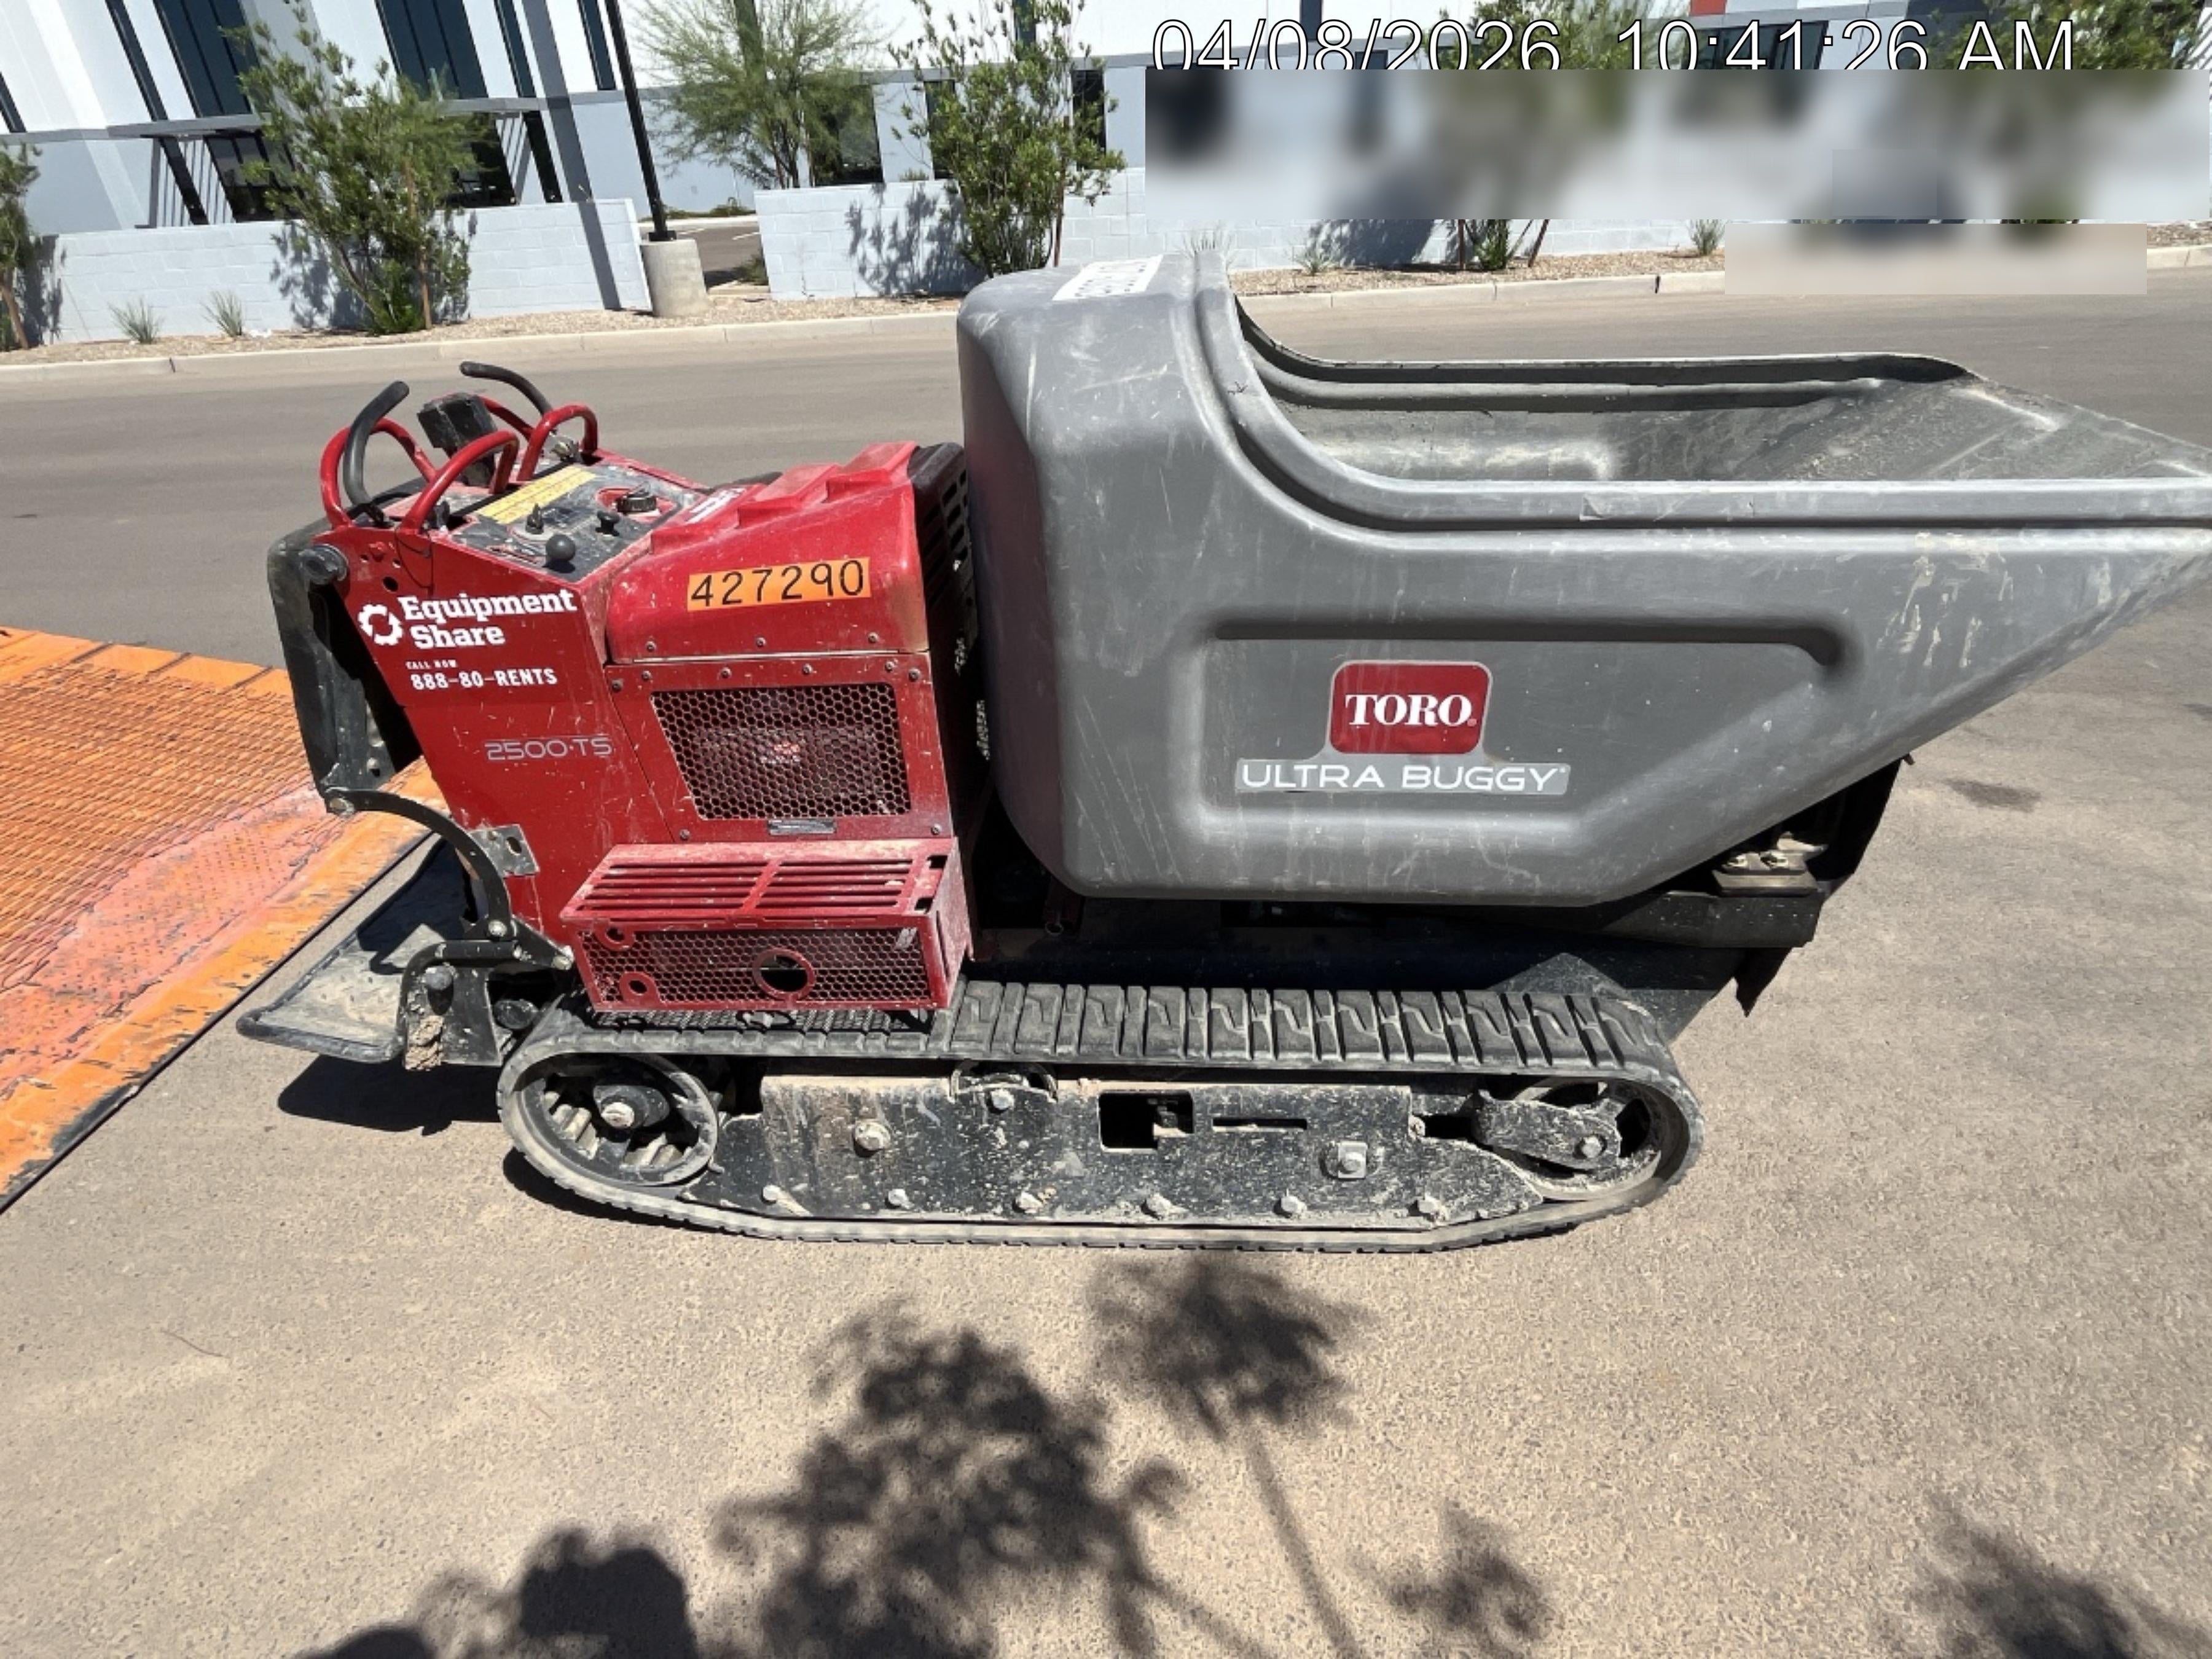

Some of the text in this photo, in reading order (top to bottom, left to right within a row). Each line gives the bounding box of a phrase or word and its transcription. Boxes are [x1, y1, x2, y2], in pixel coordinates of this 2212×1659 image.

[691, 560, 864, 607] 427290
[398, 589, 577, 624] Equipment
[409, 625, 506, 649] Share
[433, 659, 458, 668] NOW
[411, 668, 558, 690] 888-80-RENTS
[1345, 694, 1473, 727] TORO
[1242, 764, 1558, 791] ULTRA BUGGY
